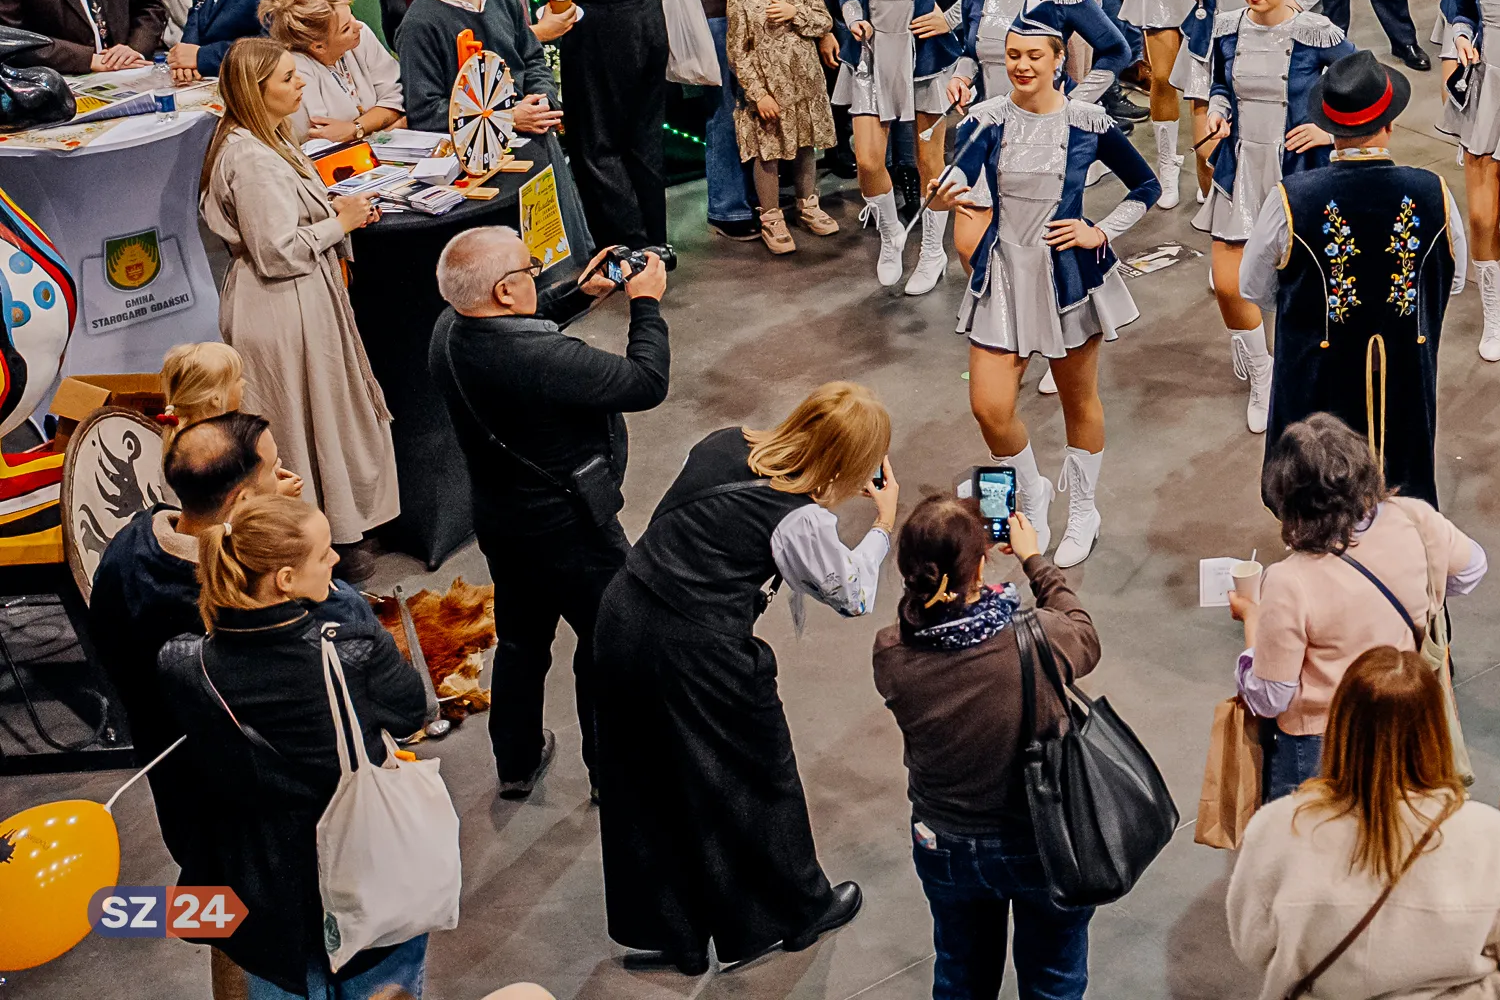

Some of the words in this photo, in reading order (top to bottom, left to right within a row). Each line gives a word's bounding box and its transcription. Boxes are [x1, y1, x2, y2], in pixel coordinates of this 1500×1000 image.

[91, 307, 148, 329] STAROGARD
[151, 293, 190, 313] GDAŃSKI
[125, 293, 156, 309] GMINA
